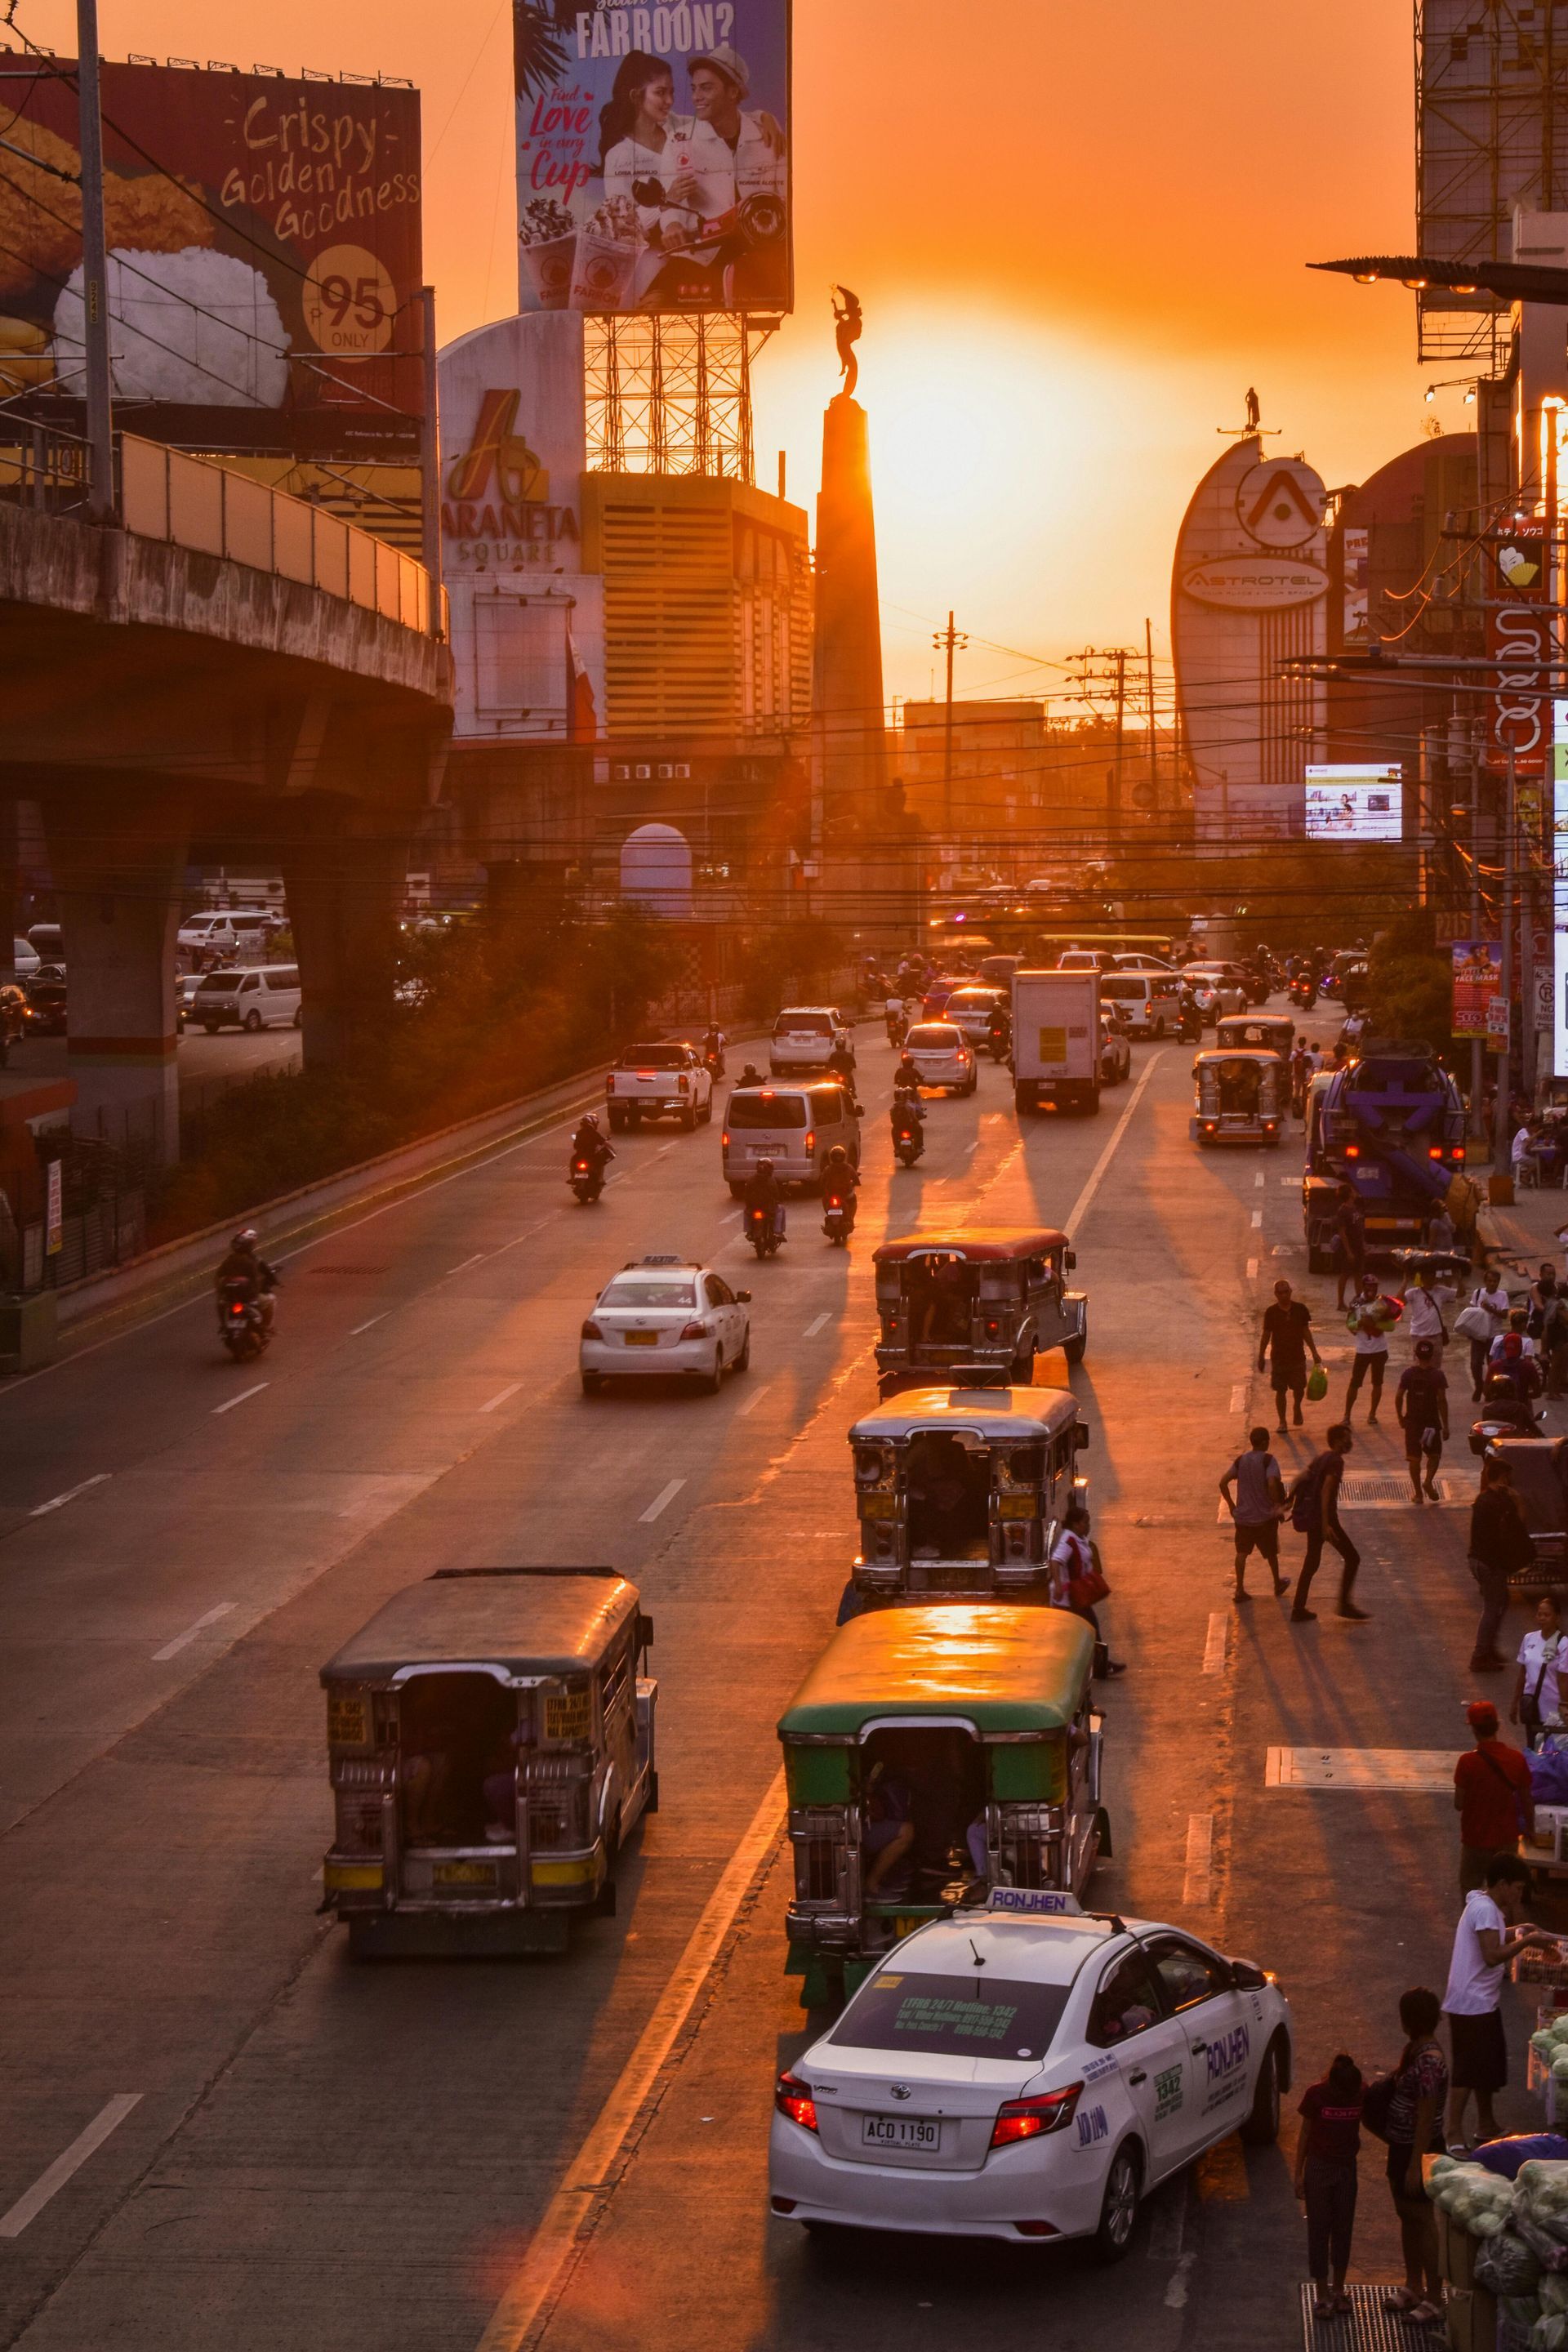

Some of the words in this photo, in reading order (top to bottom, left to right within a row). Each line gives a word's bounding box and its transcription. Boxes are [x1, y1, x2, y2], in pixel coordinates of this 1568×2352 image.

[243, 96, 377, 174] Crispy
[529, 94, 593, 137] Love
[220, 152, 335, 207] Golden
[531, 150, 590, 205] Cup
[275, 173, 421, 241] Goodness
[332, 332, 369, 347] ONLY
[441, 503, 581, 542] ARANETA
[459, 541, 557, 565] SQUARE
[1187, 572, 1323, 587] ASTROTEL
[992, 1891, 1066, 1911] RONJHEN
[866, 2122, 895, 2139] ACD
[900, 2124, 934, 2142] 1190
